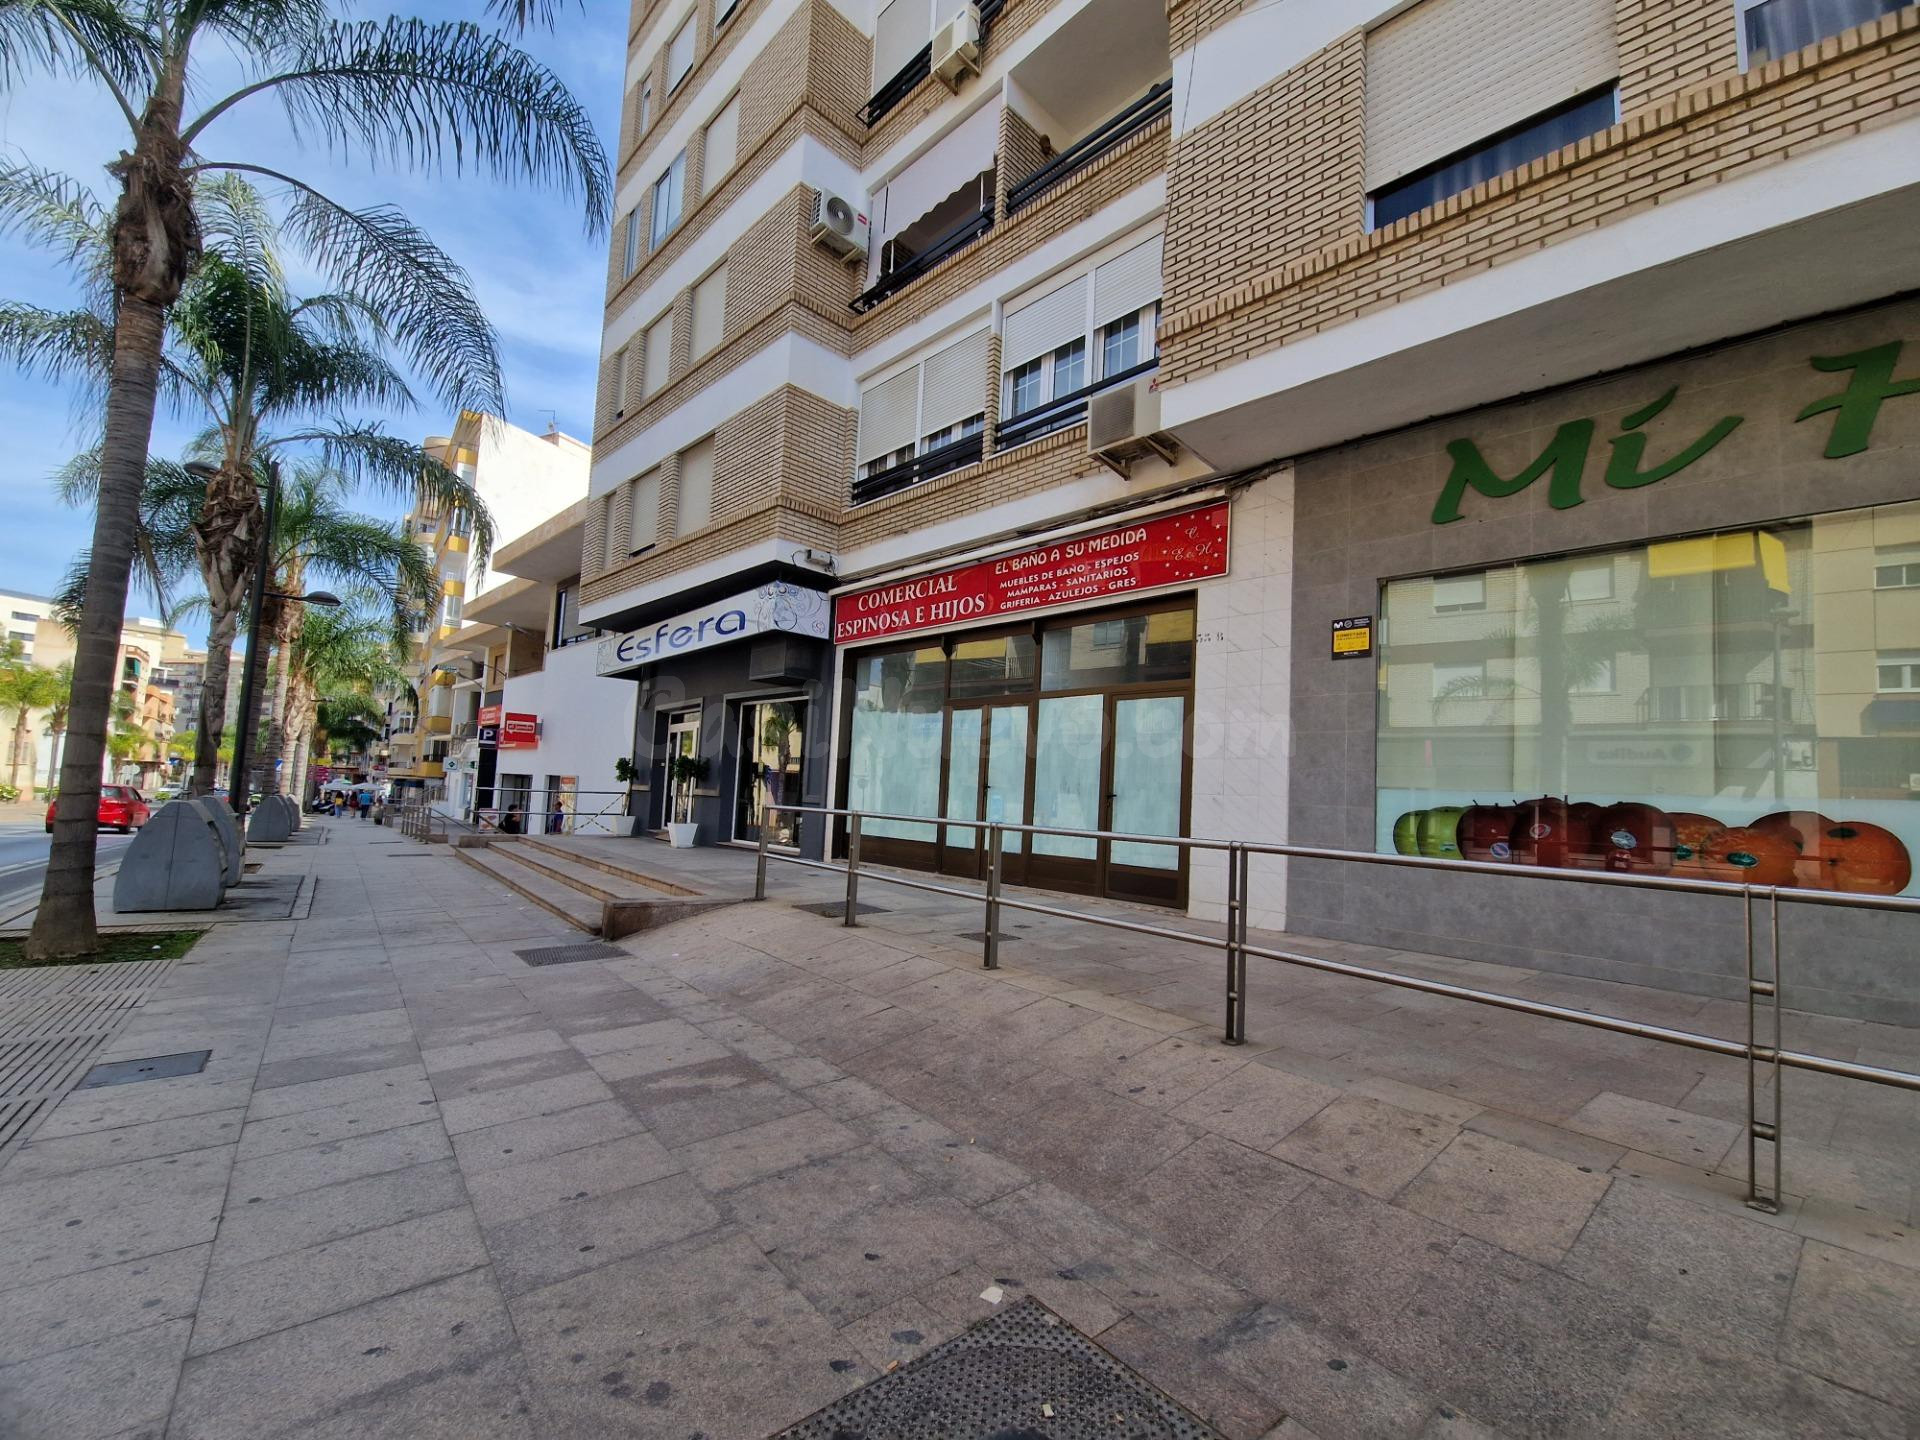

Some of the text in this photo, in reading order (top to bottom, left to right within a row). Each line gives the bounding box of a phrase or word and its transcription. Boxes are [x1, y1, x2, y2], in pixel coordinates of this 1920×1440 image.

[995, 528, 1147, 575] EL BAÑO A SU MEDIDA
[999, 574, 1039, 589] MUEBLES
[1041, 570, 1053, 580] DE
[1094, 551, 1140, 570] ESPEJOS
[858, 574, 958, 612] COMERCIAL
[1000, 596, 1040, 610] GRIFERIA
[1048, 585, 1098, 602] AZULEJOS
[1108, 577, 1137, 590] GRES
[1006, 581, 1057, 598] MAMPARAS
[1066, 566, 1129, 587] SANITARIOS
[837, 593, 985, 638] ESPINOSA E HIJOS
[616, 610, 746, 662] Esfera
[483, 730, 494, 740] P
